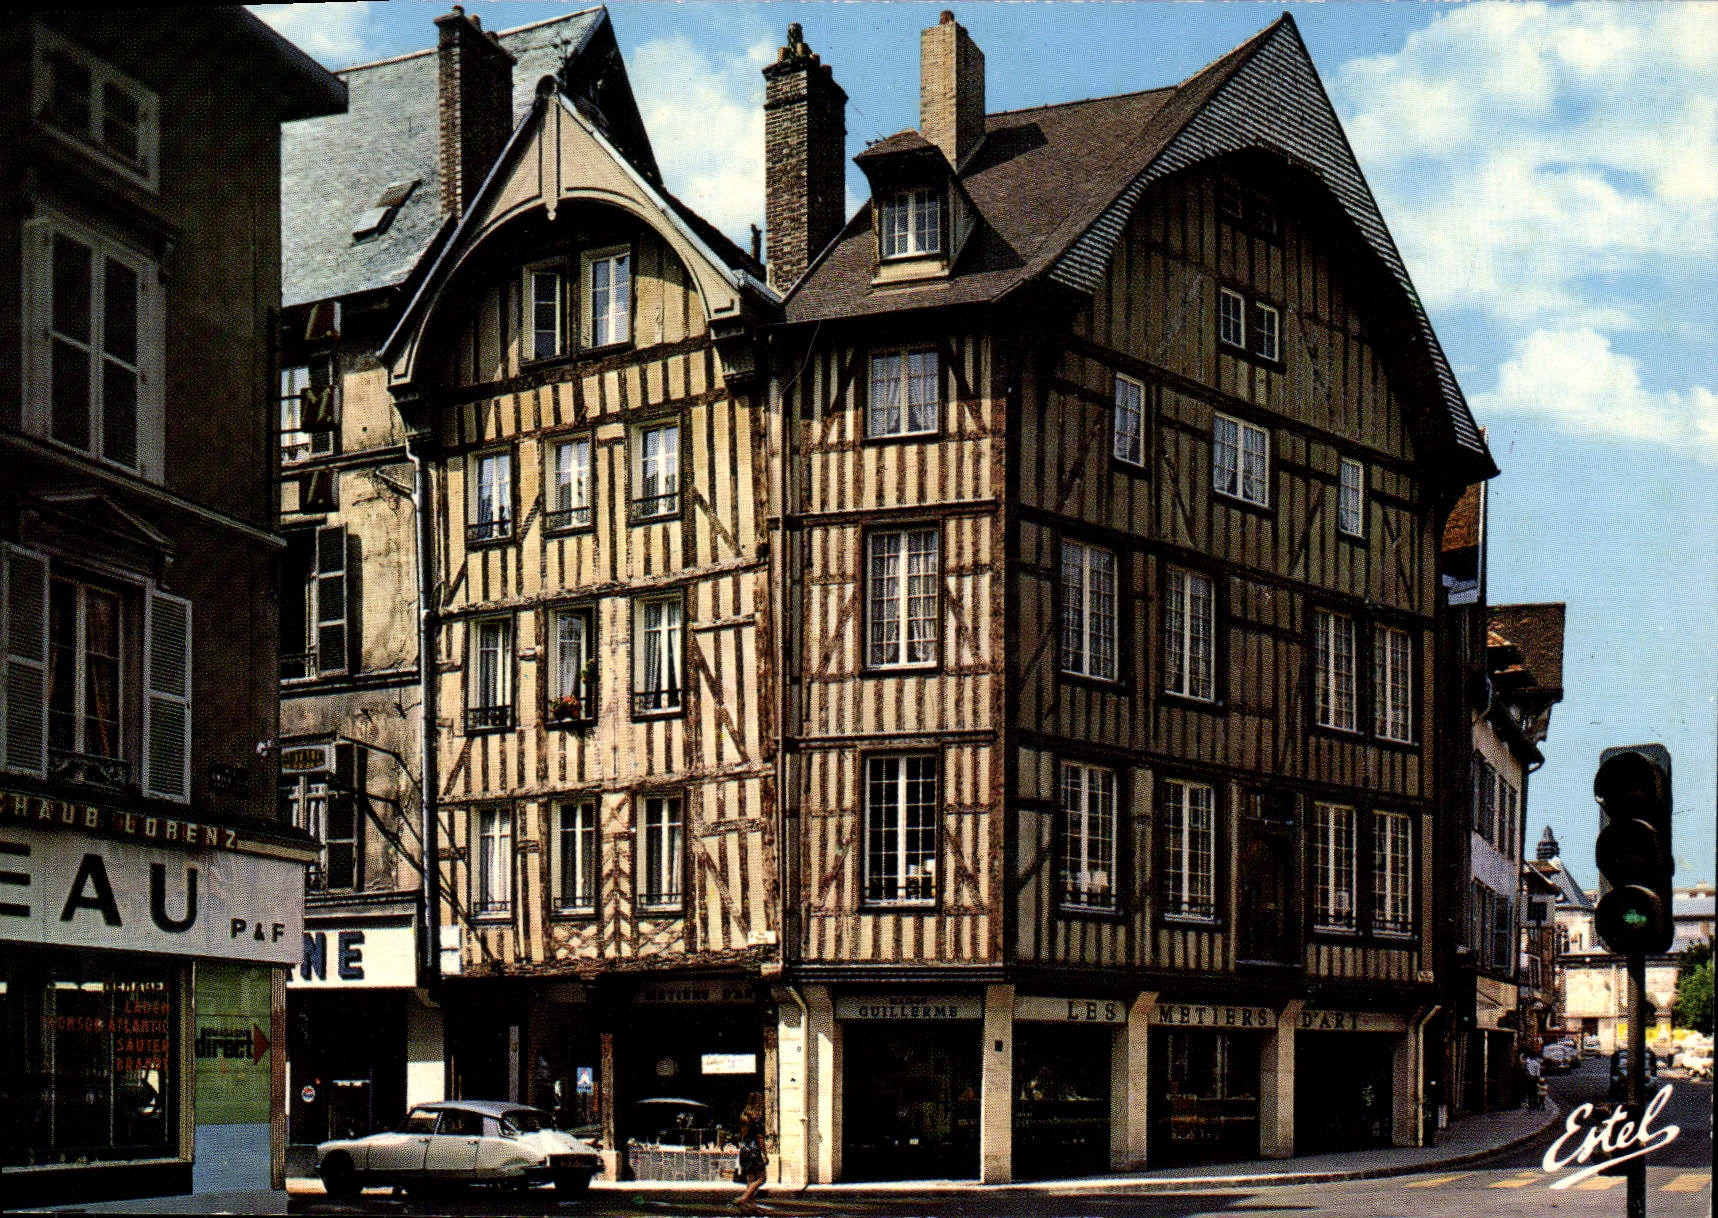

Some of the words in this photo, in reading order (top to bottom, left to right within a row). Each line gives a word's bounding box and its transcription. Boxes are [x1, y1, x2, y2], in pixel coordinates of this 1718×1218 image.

[0, 795, 98, 829] HAUB
[124, 812, 236, 849] LORENZ
[1067, 1001, 1117, 1021] LES
[1303, 1010, 1359, 1030] D'ART
